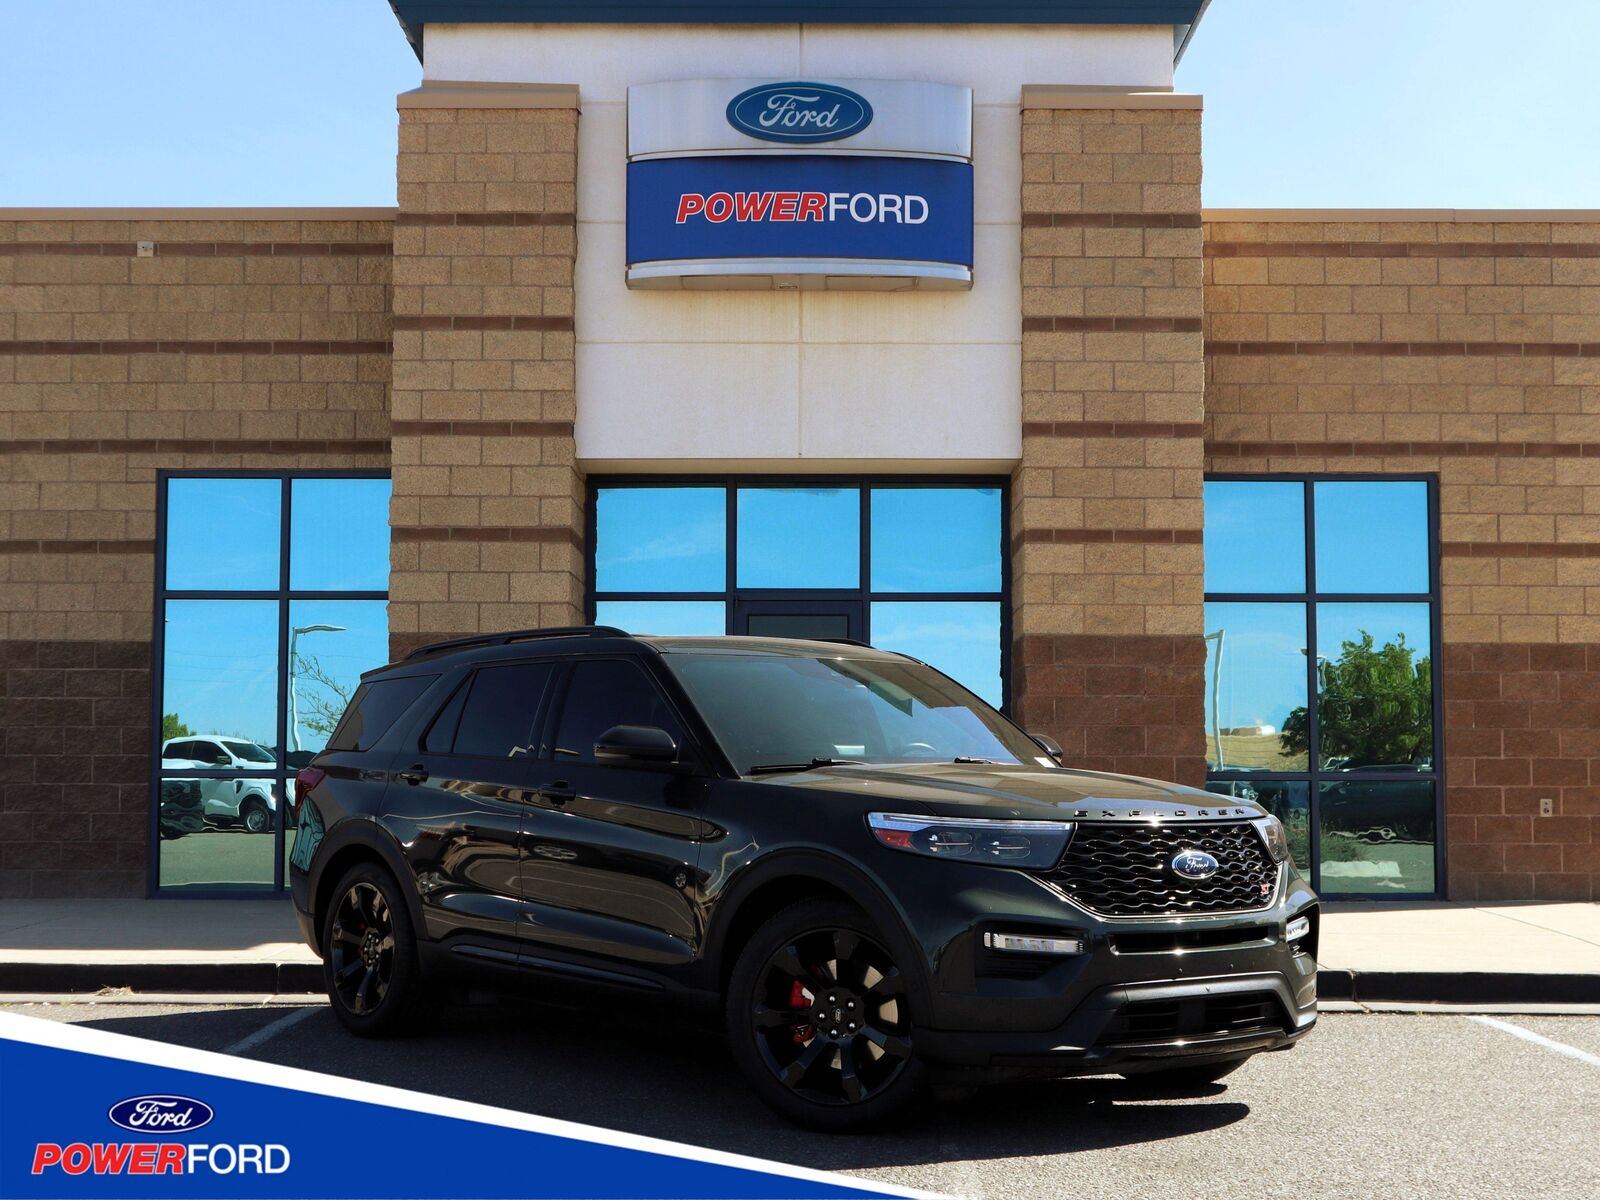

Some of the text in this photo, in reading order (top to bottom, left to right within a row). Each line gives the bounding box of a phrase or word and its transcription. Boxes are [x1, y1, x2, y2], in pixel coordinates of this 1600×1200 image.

[759, 94, 840, 128] Ford
[1073, 808, 1245, 818] EXPLORER
[1186, 857, 1210, 873] Ford
